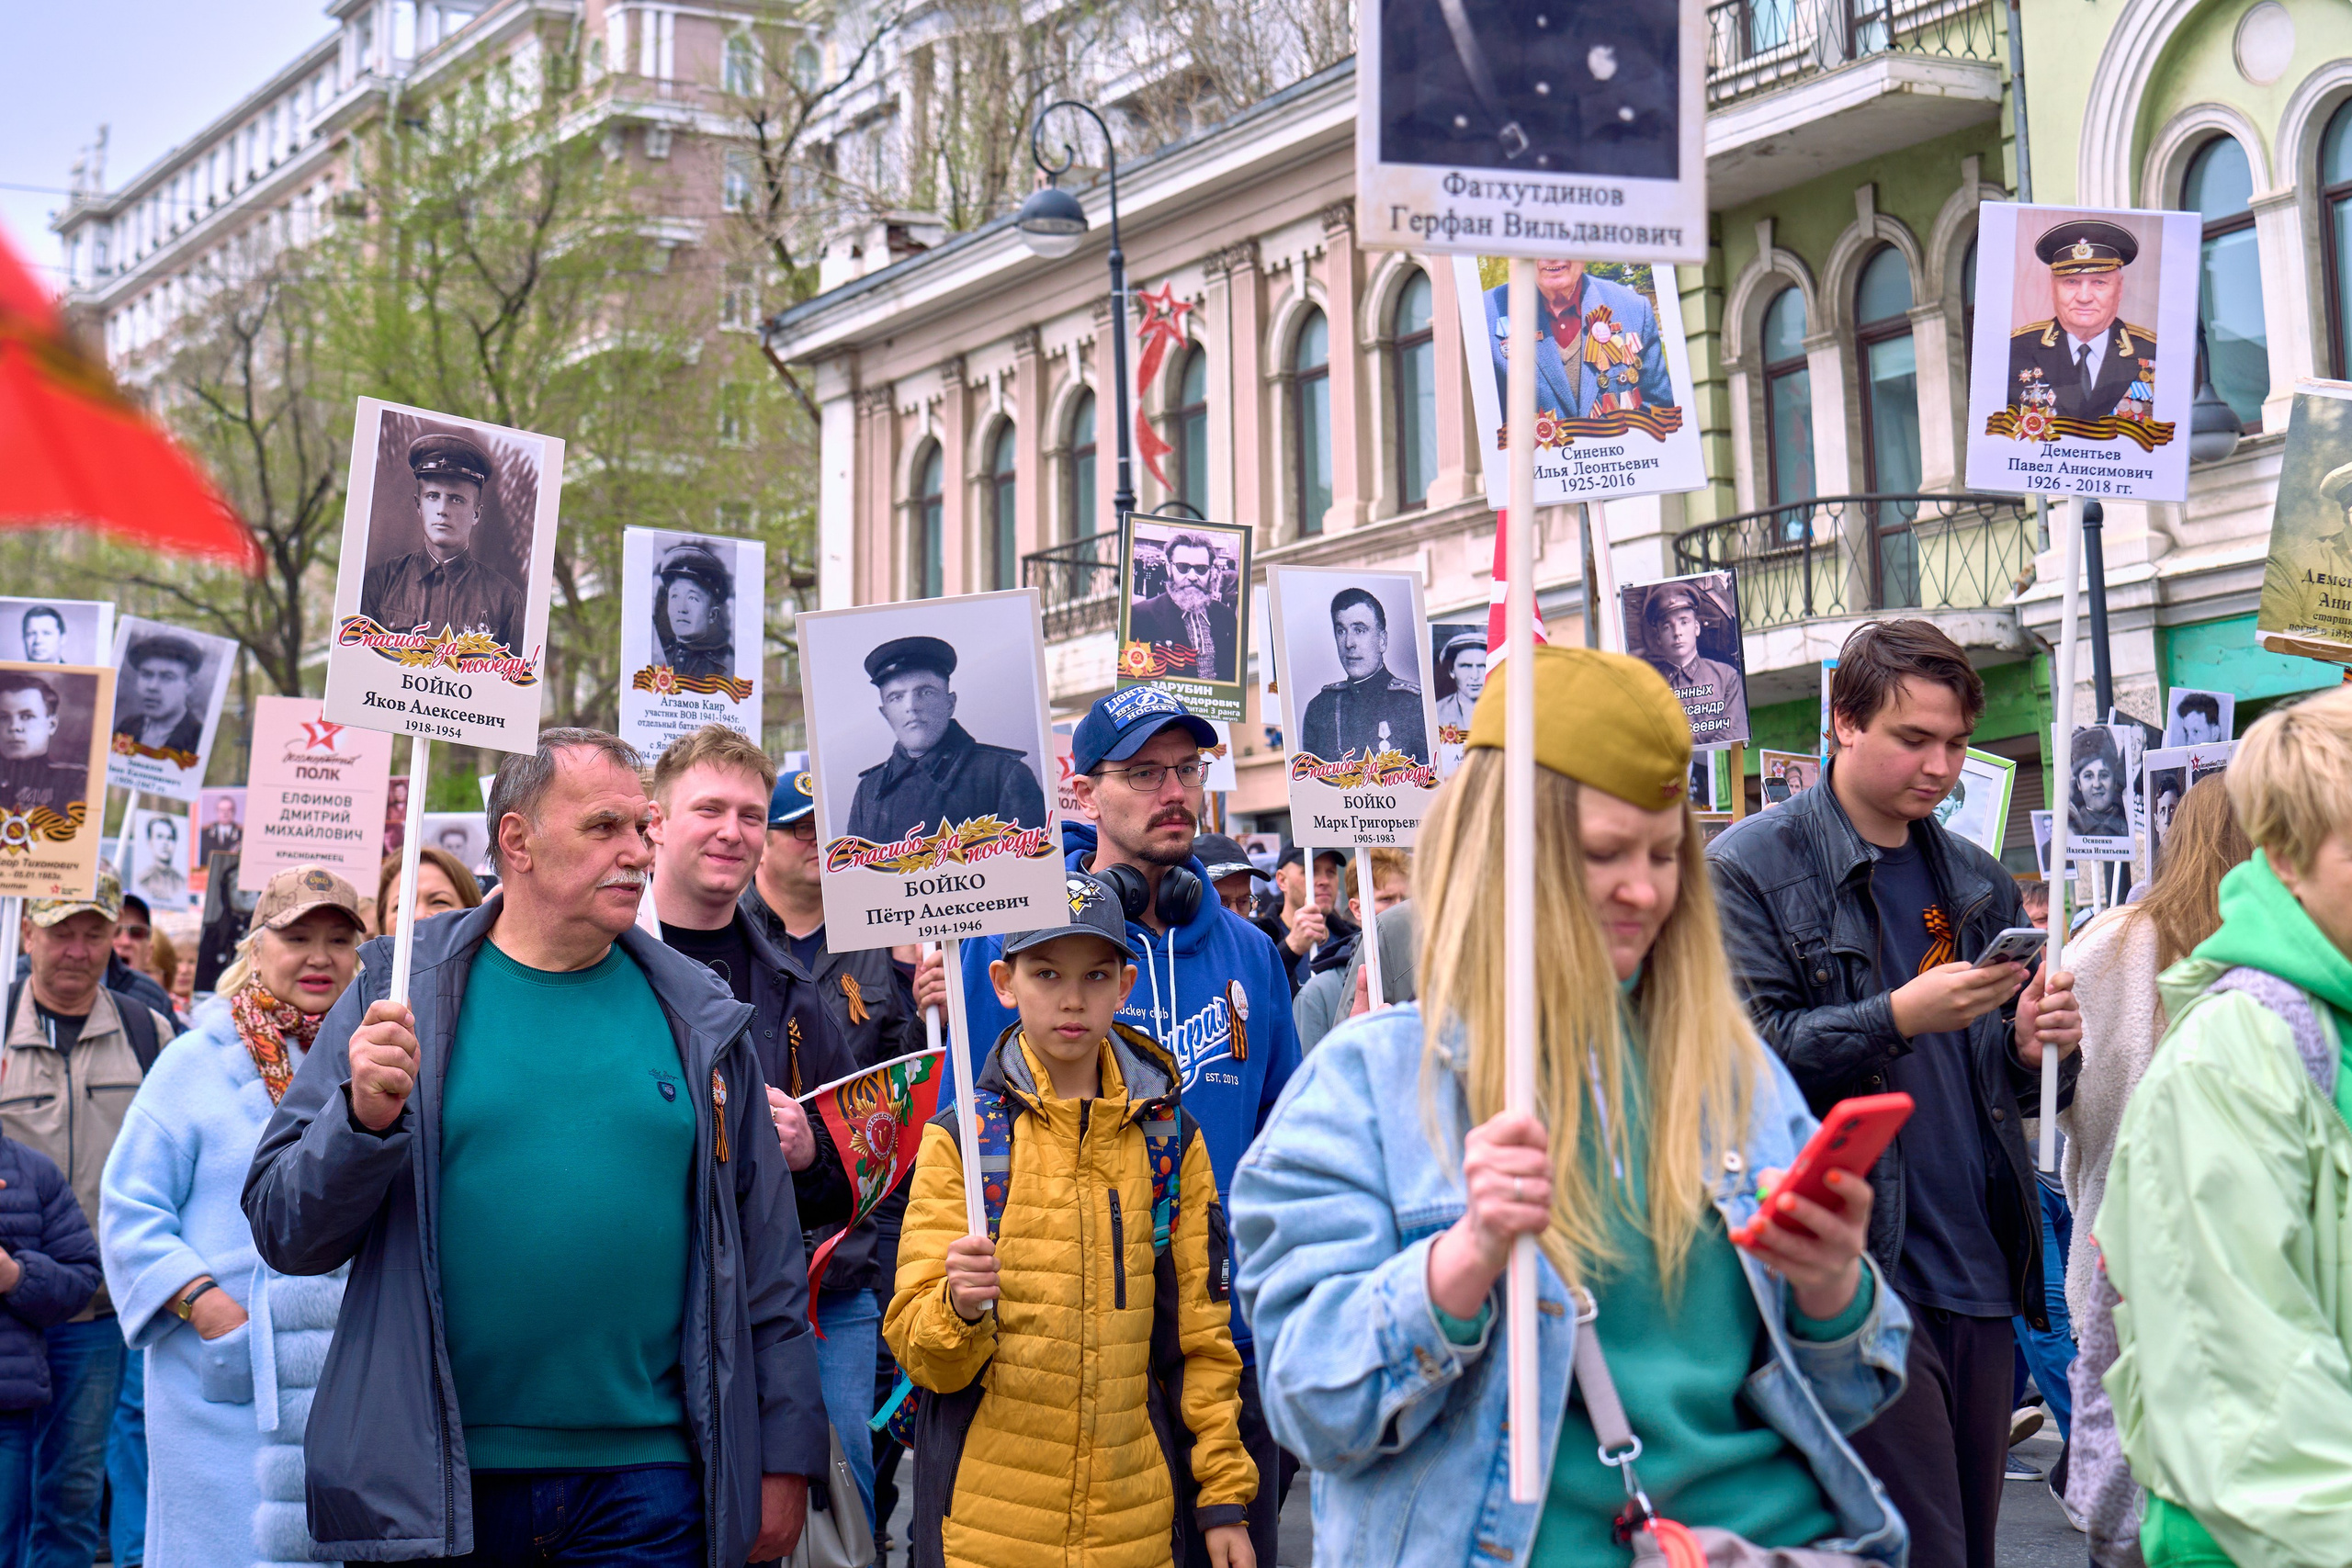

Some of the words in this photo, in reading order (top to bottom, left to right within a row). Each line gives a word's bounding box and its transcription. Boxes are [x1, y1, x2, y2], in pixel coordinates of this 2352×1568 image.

[1442, 172, 1624, 207] Фатхутдинов
[1390, 205, 1493, 242] Герфан
[1503, 212, 1683, 246] Вильданович
[1561, 445, 1624, 461] Синенко
[2041, 444, 2121, 461] Дементьев
[1572, 457, 1659, 476] Леонтьевич
[2007, 457, 2053, 473] Павел
[2057, 461, 2154, 479] Анисимович
[1561, 472, 1635, 493] 1925-2016
[2027, 475, 2061, 491] 1926
[2075, 478, 2111, 493] 2018
[2116, 484, 2133, 495] гг.
[338, 618, 426, 647] Спасибо
[432, 641, 459, 669] за
[460, 644, 541, 682] победу!
[401, 673, 472, 699] БОЙКО
[1150, 680, 1213, 696] ЗАРУБИН
[1670, 684, 1713, 699] анных
[362, 691, 406, 712] Яков
[409, 699, 506, 728] Алексеевич
[661, 697, 700, 709] Агзамов
[702, 699, 726, 713] Каир
[1115, 704, 1135, 718] EST.
[1126, 705, 1176, 721] HOCKEY
[1217, 708, 1240, 716] ранга
[644, 709, 678, 717] участник
[680, 710, 697, 720] ВОВ
[405, 719, 462, 739] 1918-1954
[638, 719, 677, 728] отдельный
[295, 766, 341, 781] ПОЛК
[1292, 748, 1355, 781] Спасибо
[1362, 761, 1379, 787] за
[1384, 750, 1438, 788] победу!
[281, 791, 353, 807] ЕЛФИМОВ
[1343, 793, 1396, 809] БОЙКО
[279, 808, 351, 824] ДМИТРИЙ
[1313, 815, 1349, 832] Марк
[265, 823, 363, 841] МИХАЙЛОВИЧ
[1353, 834, 1396, 843] 1905-1983
[826, 821, 925, 873] Спасибо
[933, 833, 962, 867] за
[967, 809, 1054, 863] победу!
[276, 851, 345, 863] КРАСНОАРМЕЕЦ
[2094, 847, 2130, 855] Игнатьевна
[23, 858, 80, 870] Тихонович
[903, 873, 986, 897] БОЙКО
[865, 908, 915, 926] Пётр
[919, 896, 1030, 919] Алексеевич
[918, 919, 982, 937] 1914-1946
[1205, 1073, 1221, 1083] EST.
[1223, 1074, 1239, 1086] 2013
